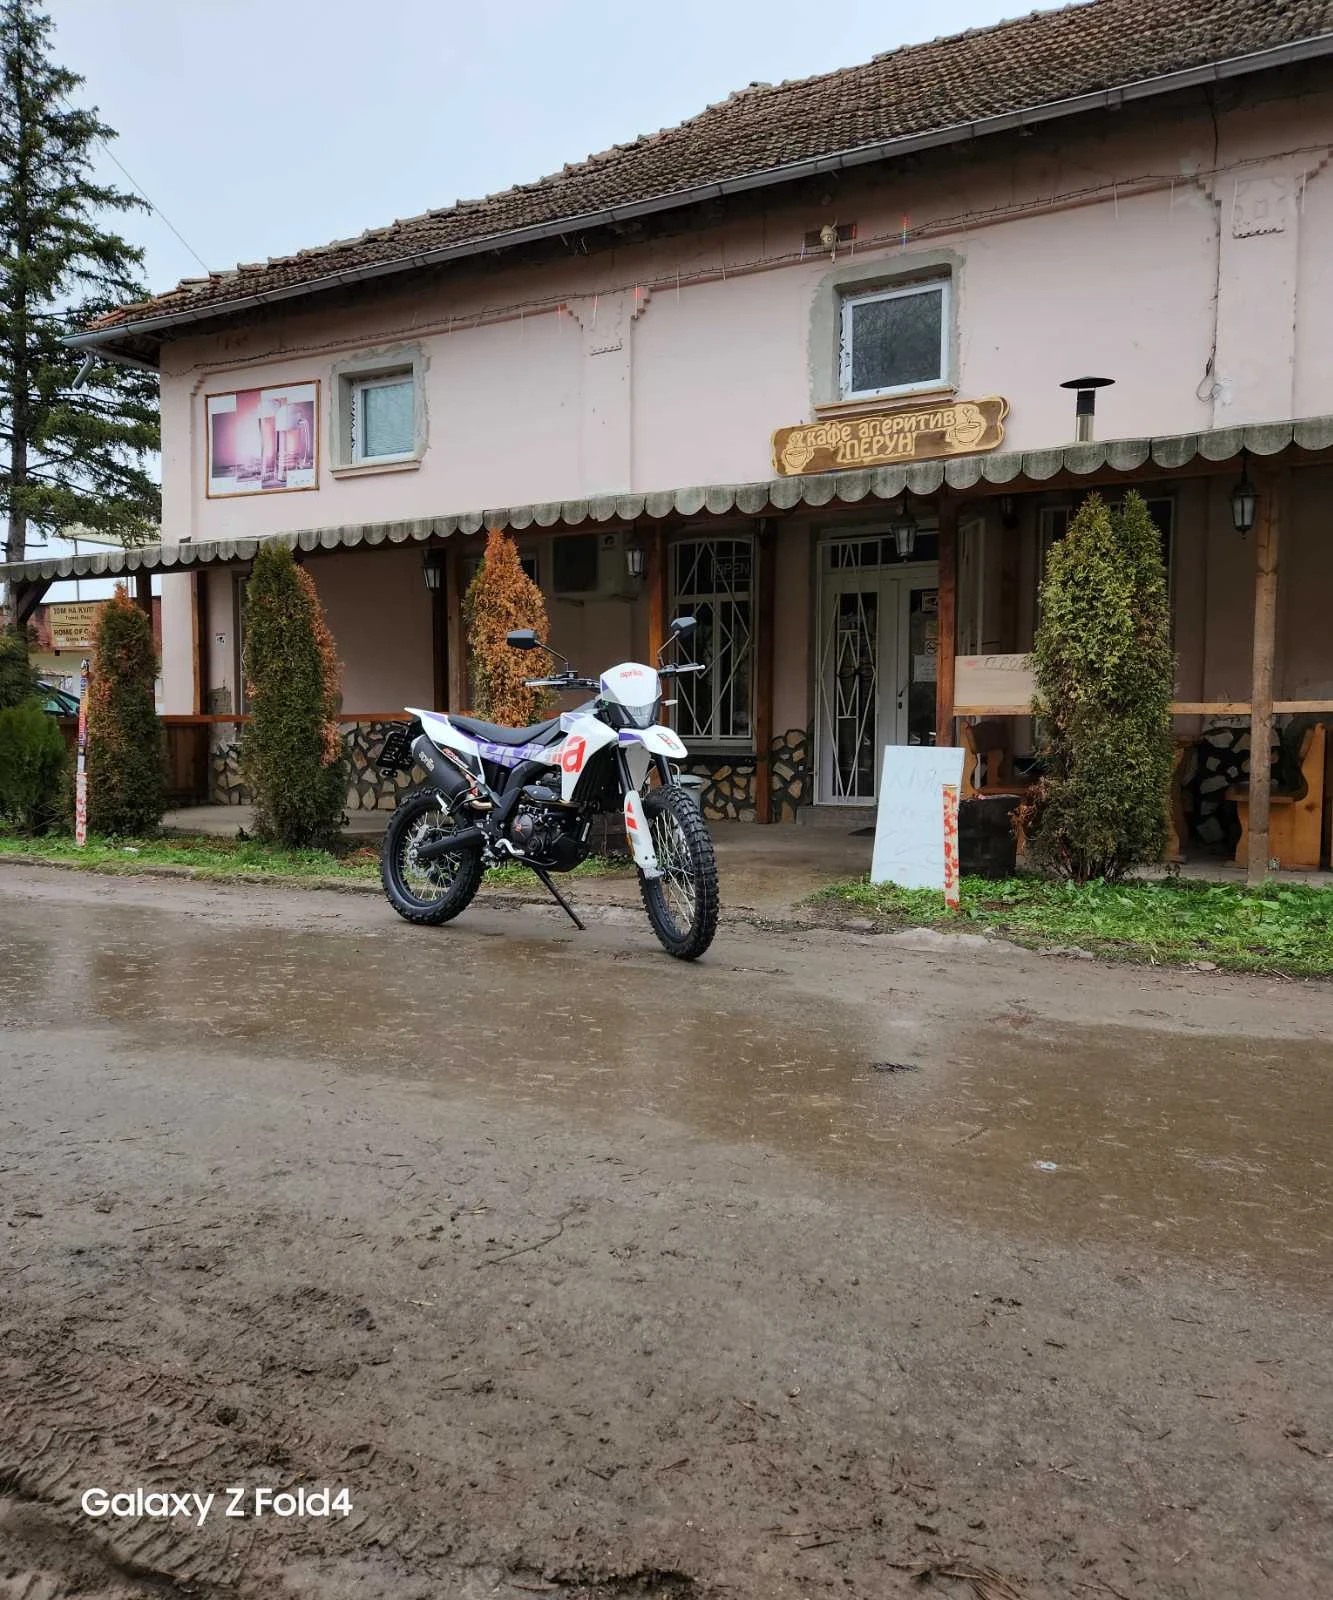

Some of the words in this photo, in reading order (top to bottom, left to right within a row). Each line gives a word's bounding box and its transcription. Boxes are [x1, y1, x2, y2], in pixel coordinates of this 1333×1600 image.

[806, 422, 850, 447] кафе
[858, 411, 956, 440] аперитив
[845, 433, 913, 459] ПЕРУН
